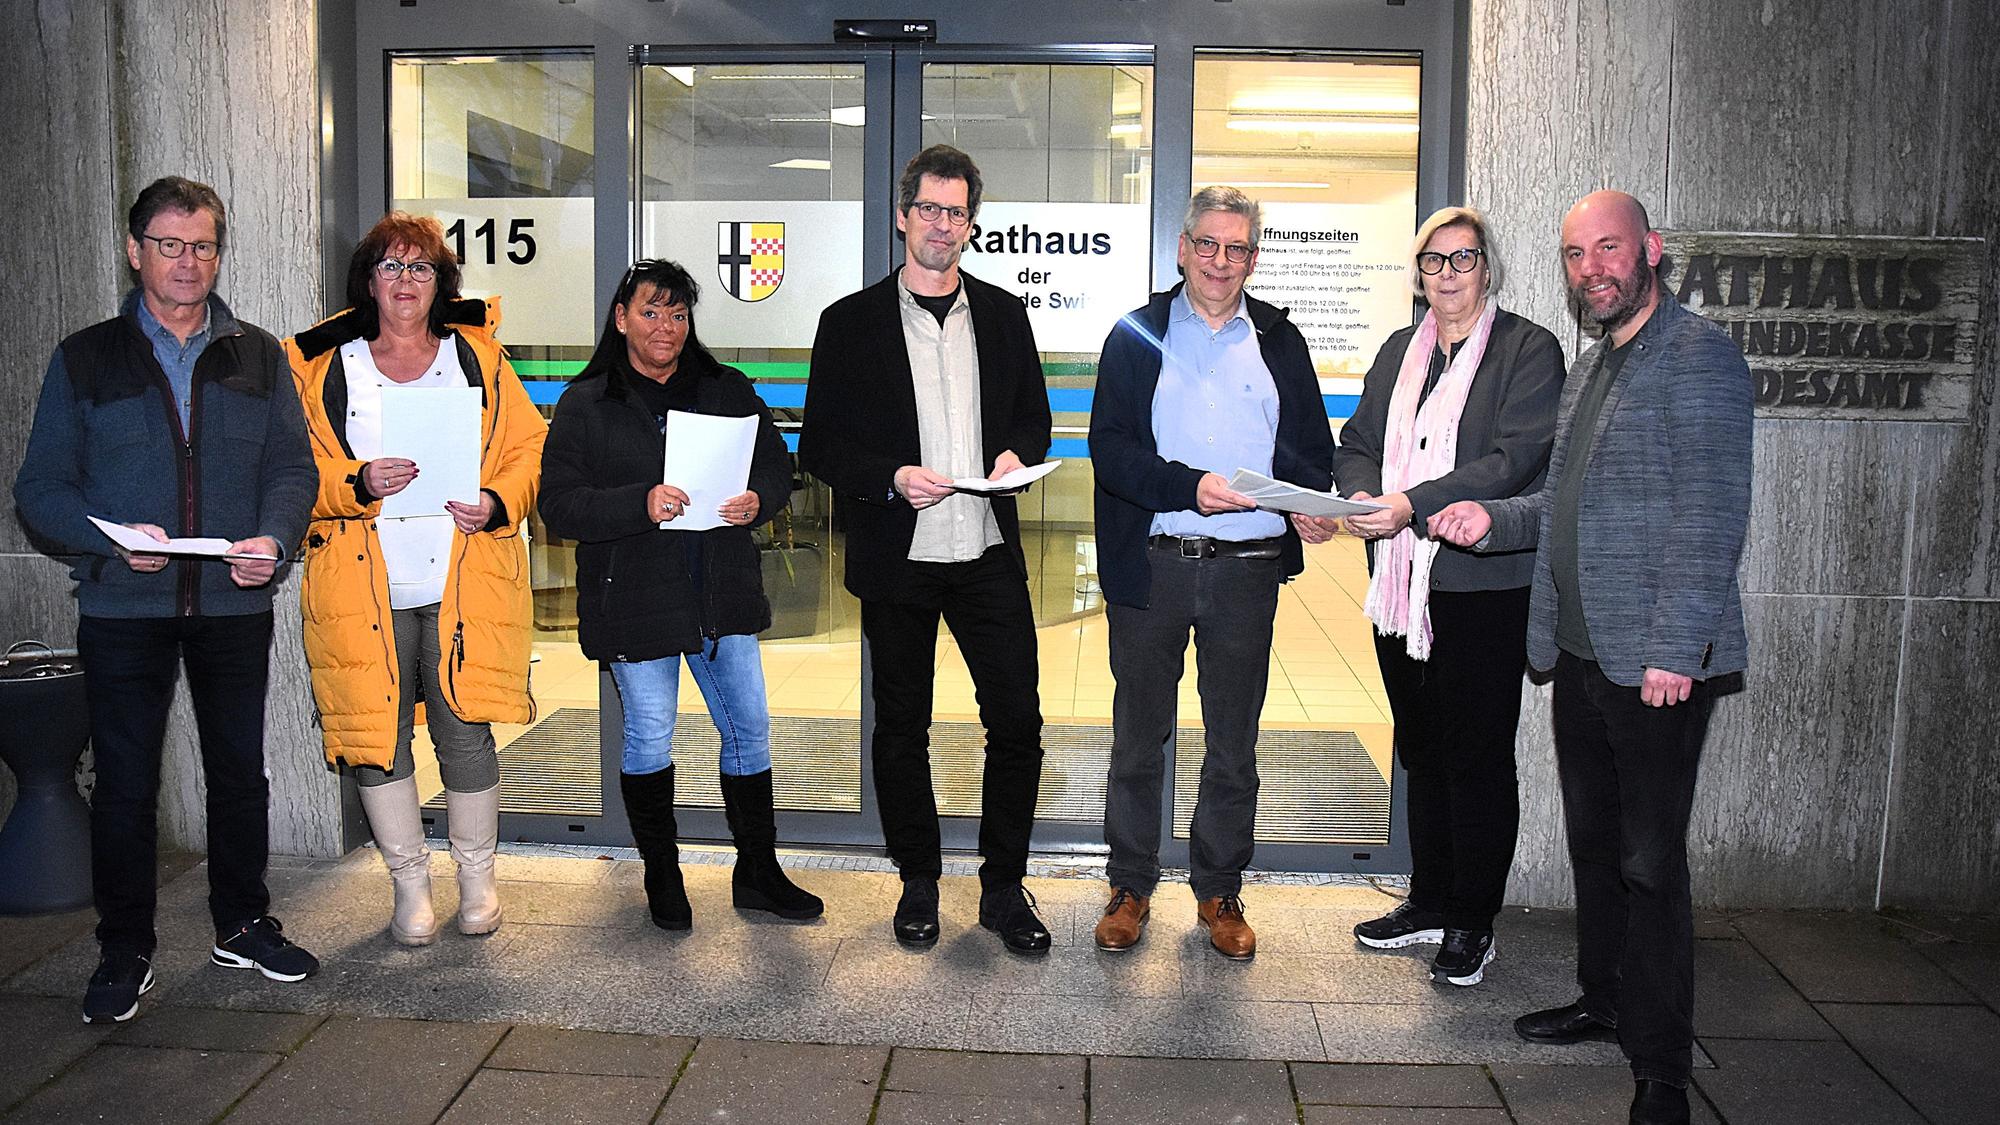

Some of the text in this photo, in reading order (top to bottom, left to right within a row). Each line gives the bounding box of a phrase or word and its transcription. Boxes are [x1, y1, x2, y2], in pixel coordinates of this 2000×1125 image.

[446, 218, 536, 265] 115
[961, 224, 1111, 255] Rathaus
[1263, 227, 1359, 242] ffnungszeiten
[1018, 267, 1051, 284] der
[1244, 283, 1276, 291] ürgerbüro
[1727, 320, 1956, 362] INDEKASSE
[1752, 369, 1932, 409] DESAMT
